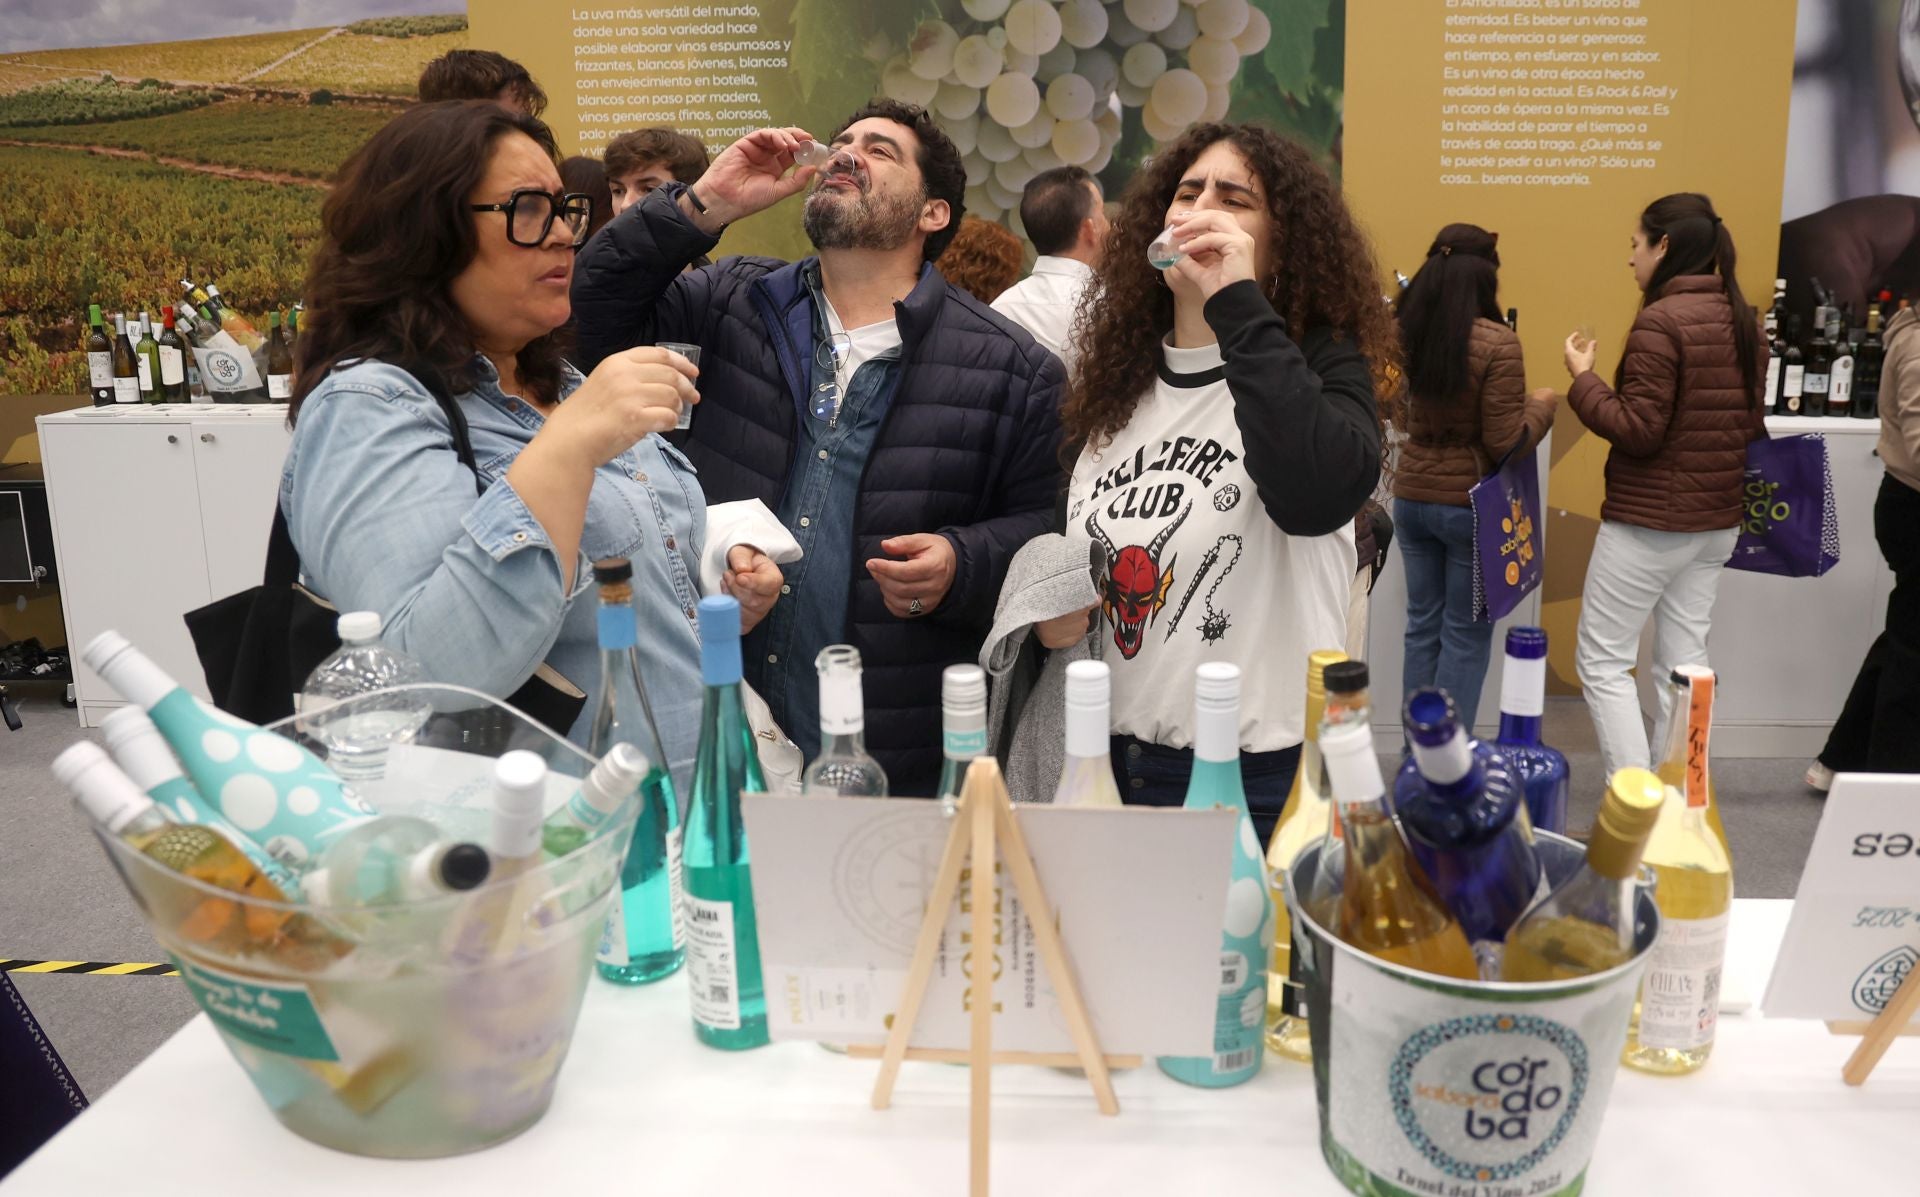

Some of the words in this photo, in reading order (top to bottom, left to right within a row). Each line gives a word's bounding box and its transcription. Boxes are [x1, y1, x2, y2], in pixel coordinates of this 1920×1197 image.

[572, 8, 588, 20] La
[591, 10, 613, 19] uva
[616, 7, 643, 19] más
[645, 6, 689, 17] versátil
[692, 5, 711, 17] del
[713, 4, 760, 17] mundo,
[1513, 13, 1530, 26] Es
[1532, 14, 1571, 25] beber
[1573, 16, 1590, 25] un
[1592, 14, 1620, 25] vino
[1622, 16, 1647, 27] que
[573, 26, 612, 37] donde
[615, 26, 638, 36] una
[641, 24, 666, 35] sola
[669, 23, 724, 34] variedad
[726, 22, 757, 33] hace
[1444, 31, 1477, 43] hace
[1479, 31, 1544, 43] referencia
[1546, 34, 1556, 43] a
[1558, 34, 1579, 43] ser
[574, 42, 618, 55] posible
[620, 42, 672, 53] elaborar
[674, 40, 707, 52] vinos
[709, 40, 780, 52] espumosos
[783, 40, 791, 52] y
[1444, 51, 1460, 60] en
[1514, 52, 1531, 61] en
[1533, 50, 1588, 61] esfuerzo
[1591, 52, 1599, 62] y
[1602, 52, 1618, 61] en
[575, 59, 634, 72] frizzantes,
[637, 58, 685, 70] blancos
[687, 56, 736, 70] jóvenes,
[739, 55, 787, 67] blancos
[1444, 66, 1460, 78] Es
[1462, 69, 1478, 78] un
[1481, 67, 1508, 78] vino
[1510, 68, 1528, 78] de
[1530, 68, 1558, 79] otra
[1560, 68, 1602, 80] época
[1604, 68, 1644, 79] hecho
[576, 79, 598, 88] con
[600, 76, 692, 88] envejecimiento
[693, 76, 710, 86] en
[712, 73, 757, 87] botella,
[577, 94, 624, 105] blancos
[626, 95, 649, 104] con
[652, 94, 683, 105] paso
[685, 94, 706, 104] por
[709, 91, 760, 104] madera,
[1443, 85, 1496, 96] realidad
[1498, 87, 1515, 96] en
[1517, 86, 1529, 96] la
[1577, 85, 1593, 97] Es
[1596, 85, 1629, 97] Rock
[1631, 86, 1640, 97] &
[1642, 85, 1667, 97] Roll
[1669, 88, 1677, 99] y
[1442, 104, 1458, 114] un
[1460, 104, 1490, 114] coro
[1492, 103, 1510, 114] de
[1512, 102, 1551, 115] ópera
[1554, 105, 1563, 114] a
[1565, 103, 1578, 115] la
[1580, 104, 1623, 115] misma
[1653, 103, 1669, 115] Es
[578, 112, 609, 122] vinos
[612, 112, 676, 124] generosos
[678, 109, 713, 122] (finos,
[716, 108, 771, 121] olorosos,
[1442, 120, 1453, 131] la
[1456, 120, 1515, 132] habilidad
[1517, 120, 1535, 132] de
[1537, 122, 1572, 133] parar
[1576, 121, 1587, 132] el
[1590, 121, 1635, 133] tiempo
[1637, 122, 1647, 132] a
[579, 127, 606, 141] palo
[1441, 138, 1481, 149] través
[1484, 138, 1501, 149] de
[1504, 138, 1536, 149] cada
[1616, 138, 1644, 150] más
[1647, 140, 1662, 150] se
[580, 146, 588, 158] y
[1440, 155, 1452, 166] le
[1454, 155, 1495, 167] puede
[1498, 156, 1531, 167] pedir
[1533, 157, 1542, 166] a
[1544, 158, 1561, 167] un
[1599, 156, 1628, 167] Sólo
[1630, 158, 1655, 168] una
[1481, 173, 1522, 184] buena
[1107, 483, 1185, 520] CLUB
[1023, 951, 1036, 1009] BODEGAS
